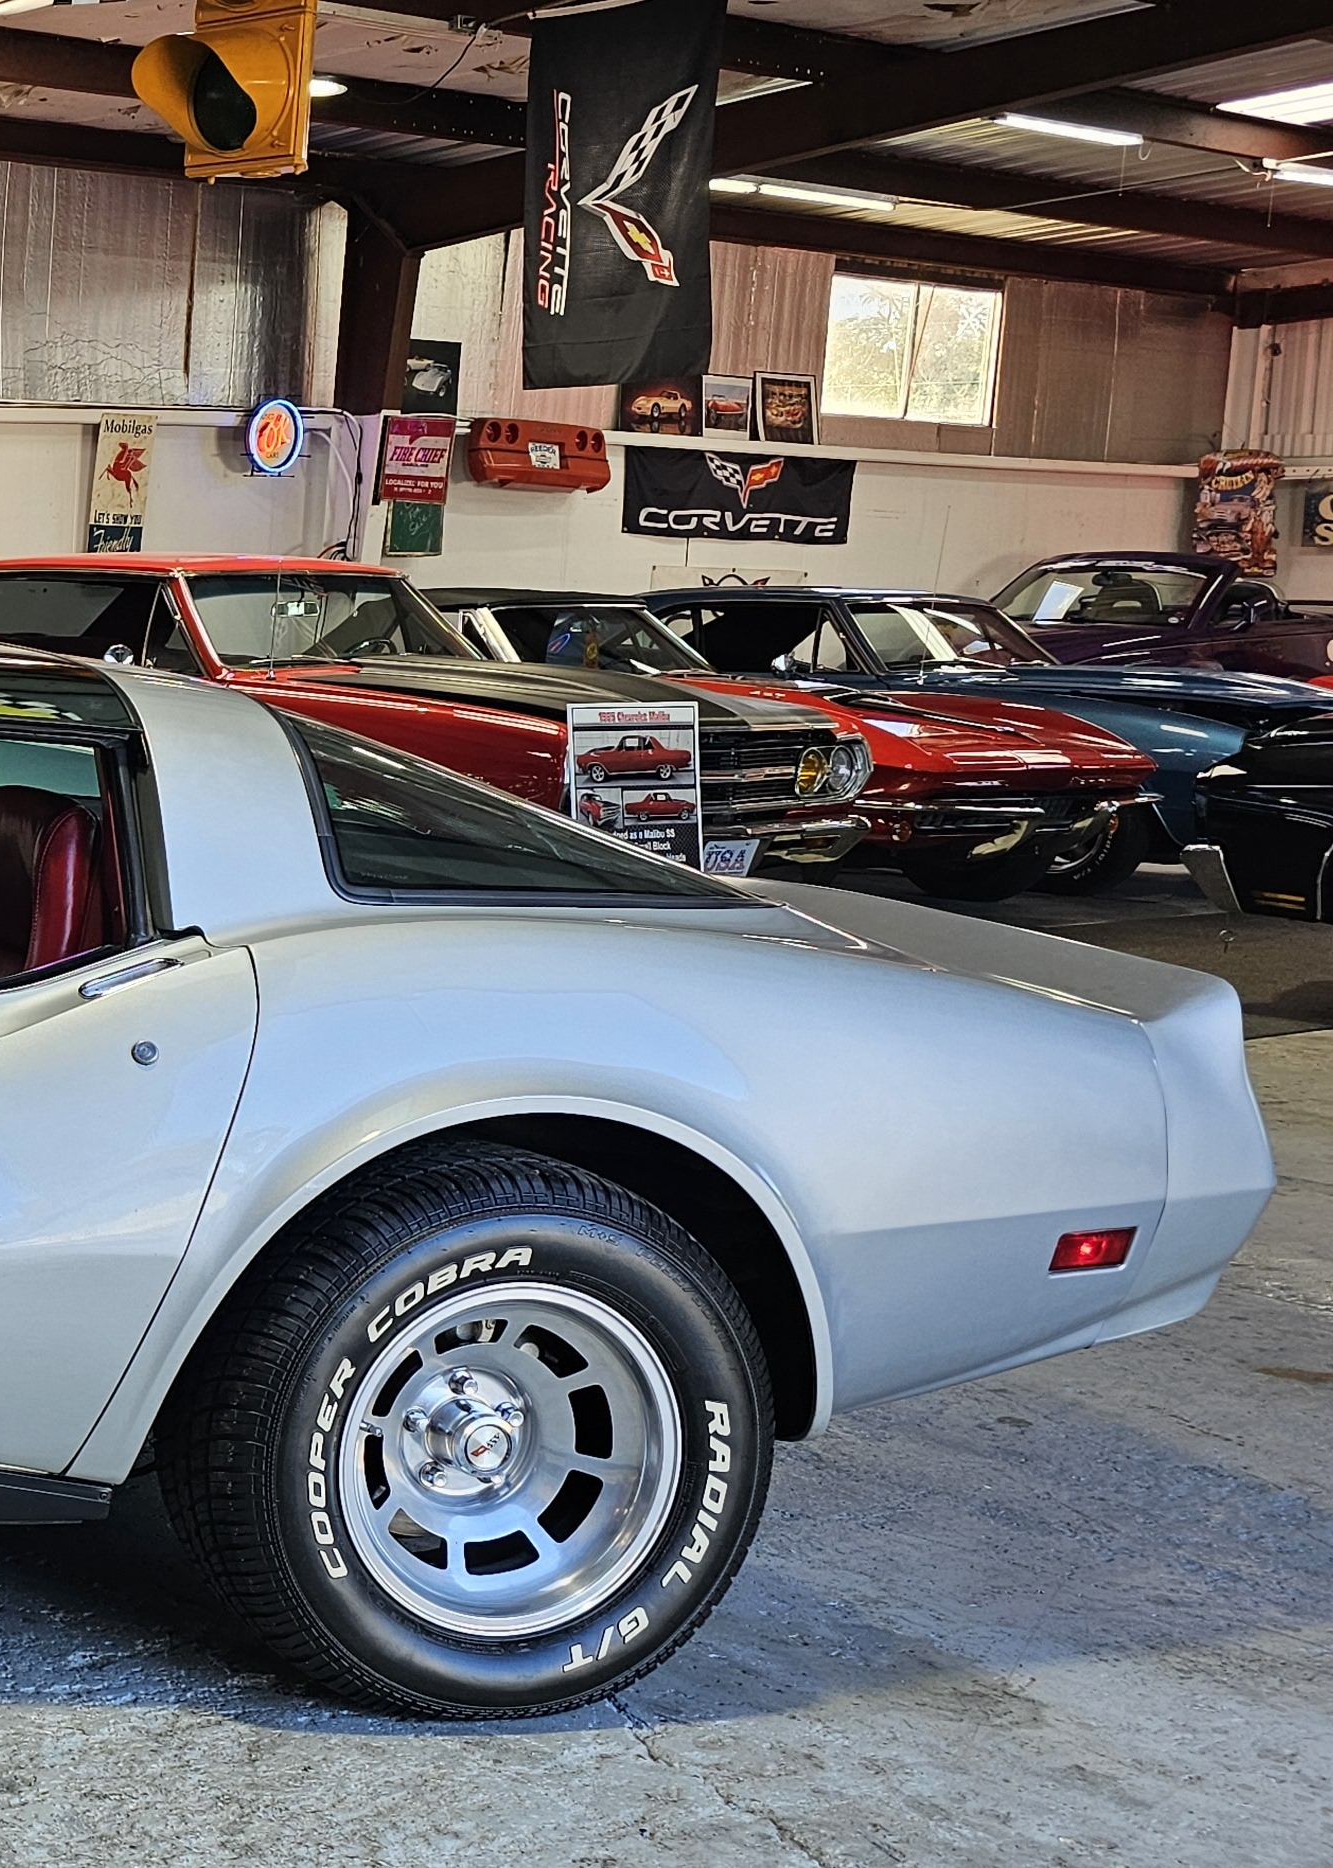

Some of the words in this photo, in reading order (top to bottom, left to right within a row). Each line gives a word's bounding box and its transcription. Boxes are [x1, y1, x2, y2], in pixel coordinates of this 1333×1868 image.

[550, 91, 572, 316] CORVETTE
[537, 143, 558, 308] RACING
[103, 419, 153, 438] Mobilgas
[389, 446, 416, 462] FIRE
[414, 447, 448, 464] CHIEF
[417, 480, 430, 488] FOR
[430, 481, 444, 489] YOU
[93, 509, 110, 524] LET'S
[130, 514, 143, 525] YOU
[639, 506, 838, 537] CORVETTE
[93, 526, 135, 552] Friendly
[617, 711, 648, 723] Chevrolet
[649, 710, 671, 722] Malibu
[644, 829, 665, 839] Malibu
[666, 829, 676, 838] SS
[653, 841, 671, 851] Block
[705, 849, 745, 872] USA
[311, 1355, 358, 1580] COOPER
[365, 1246, 534, 1343] COBRA
[661, 1400, 734, 1588] RADIAL
[562, 1606, 651, 1674] G/T
